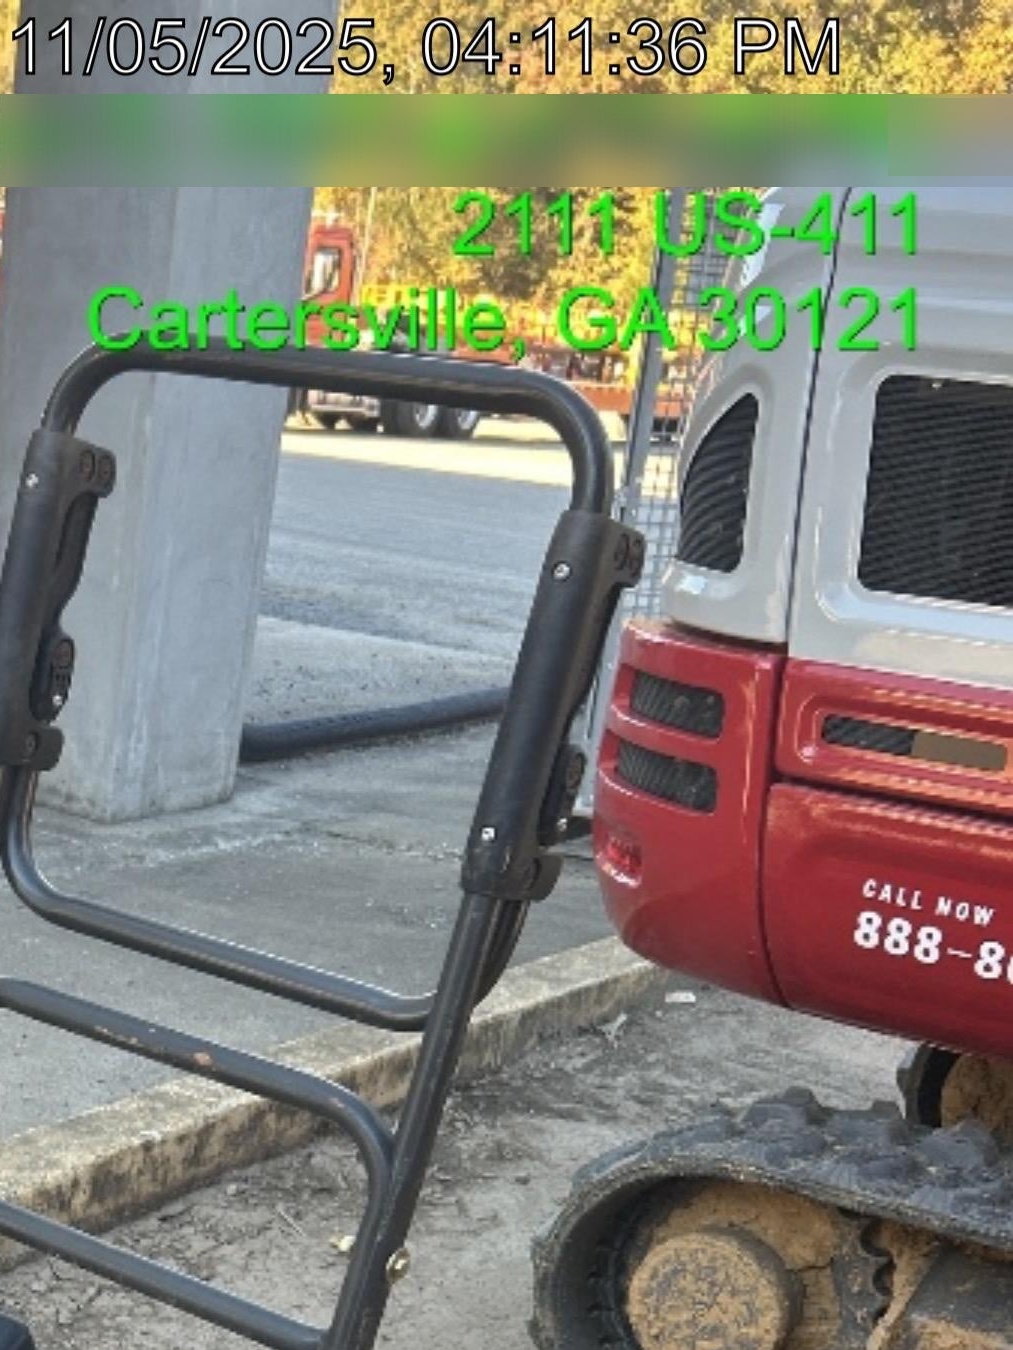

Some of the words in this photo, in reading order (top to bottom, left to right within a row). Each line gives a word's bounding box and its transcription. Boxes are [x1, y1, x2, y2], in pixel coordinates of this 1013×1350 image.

[862, 878, 922, 910] CALL
[934, 896, 995, 927] NOW
[853, 911, 1013, 985] 888-8
